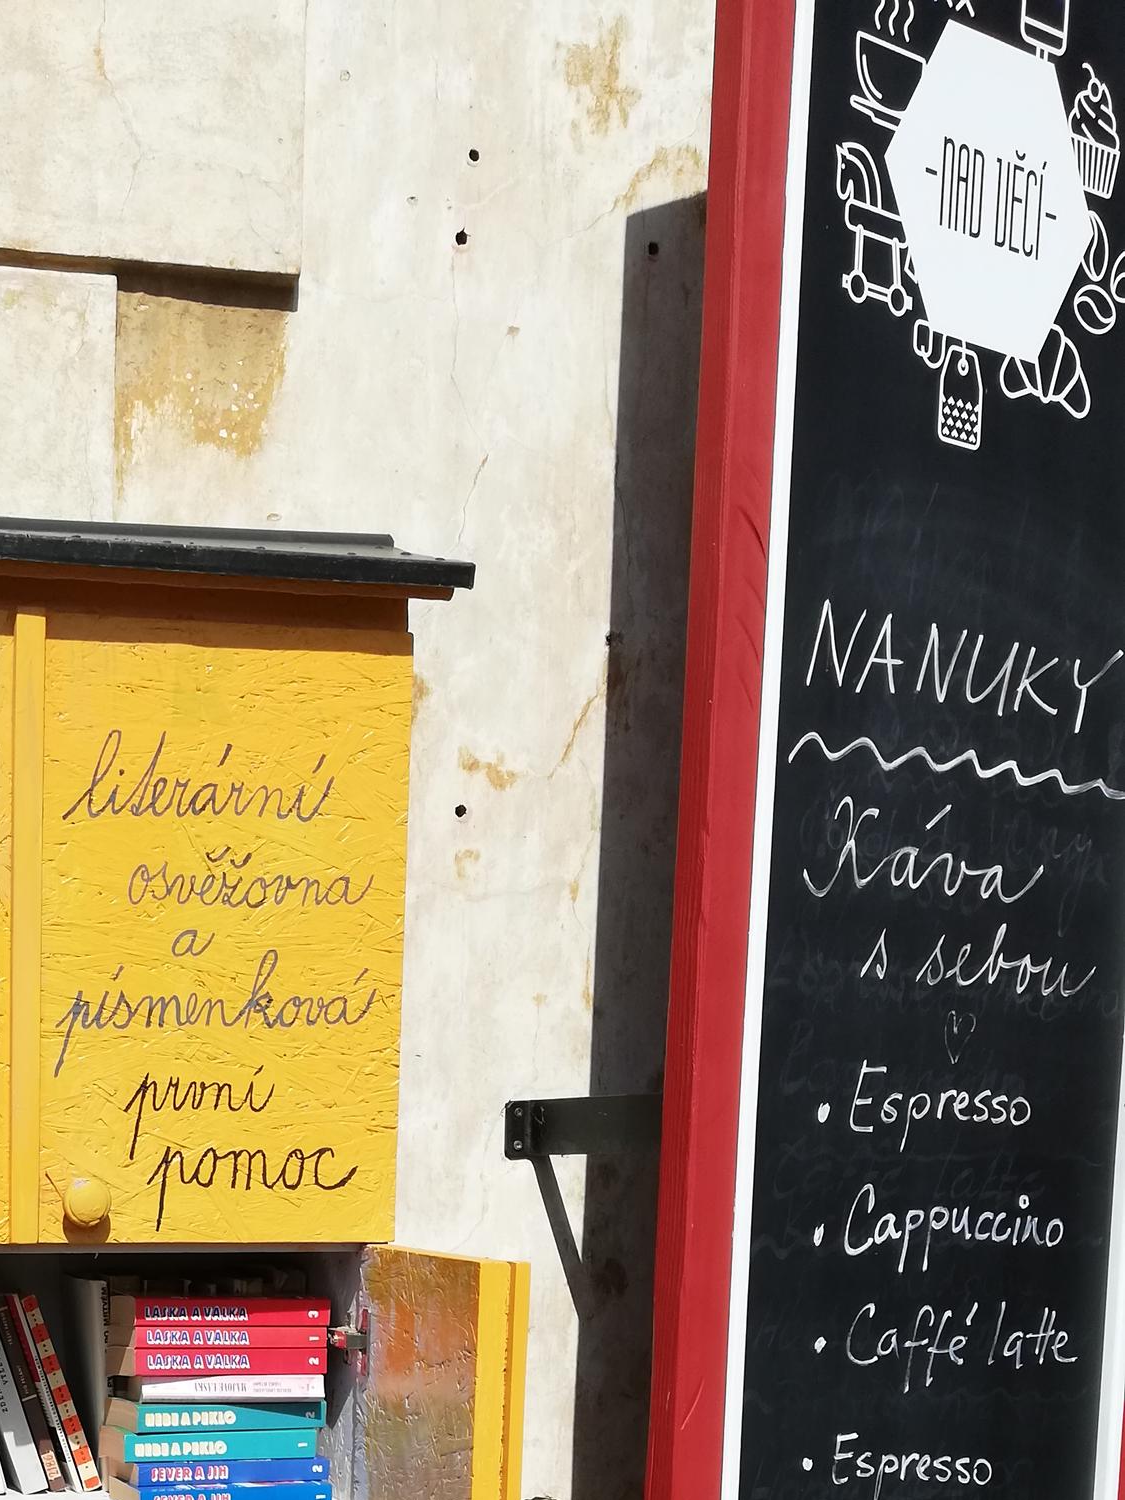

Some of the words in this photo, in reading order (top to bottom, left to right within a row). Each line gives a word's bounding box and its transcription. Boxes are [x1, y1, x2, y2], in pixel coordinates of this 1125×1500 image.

[62, 729, 335, 822] literární
[127, 846, 374, 909] osvěžovna
[803, 795, 1045, 904] Káva
[171, 928, 216, 959] a
[860, 928, 888, 980] s
[916, 923, 1097, 997] sebou
[54, 950, 376, 1079] písmenková
[126, 1065, 275, 1160] první
[849, 1059, 1031, 1152] Espresso
[147, 1145, 359, 1232] pomoc
[843, 1183, 1065, 1273] Cappuccino
[190, 1306, 202, 1320] A
[193, 1330, 203, 1345] A
[988, 1301, 1079, 1369] latte
[194, 1354, 204, 1369] A
[150, 1466, 193, 1482] SEVER
[194, 1466, 205, 1480] A
[207, 1465, 229, 1480] JIH
[312, 1464, 323, 1473] 2
